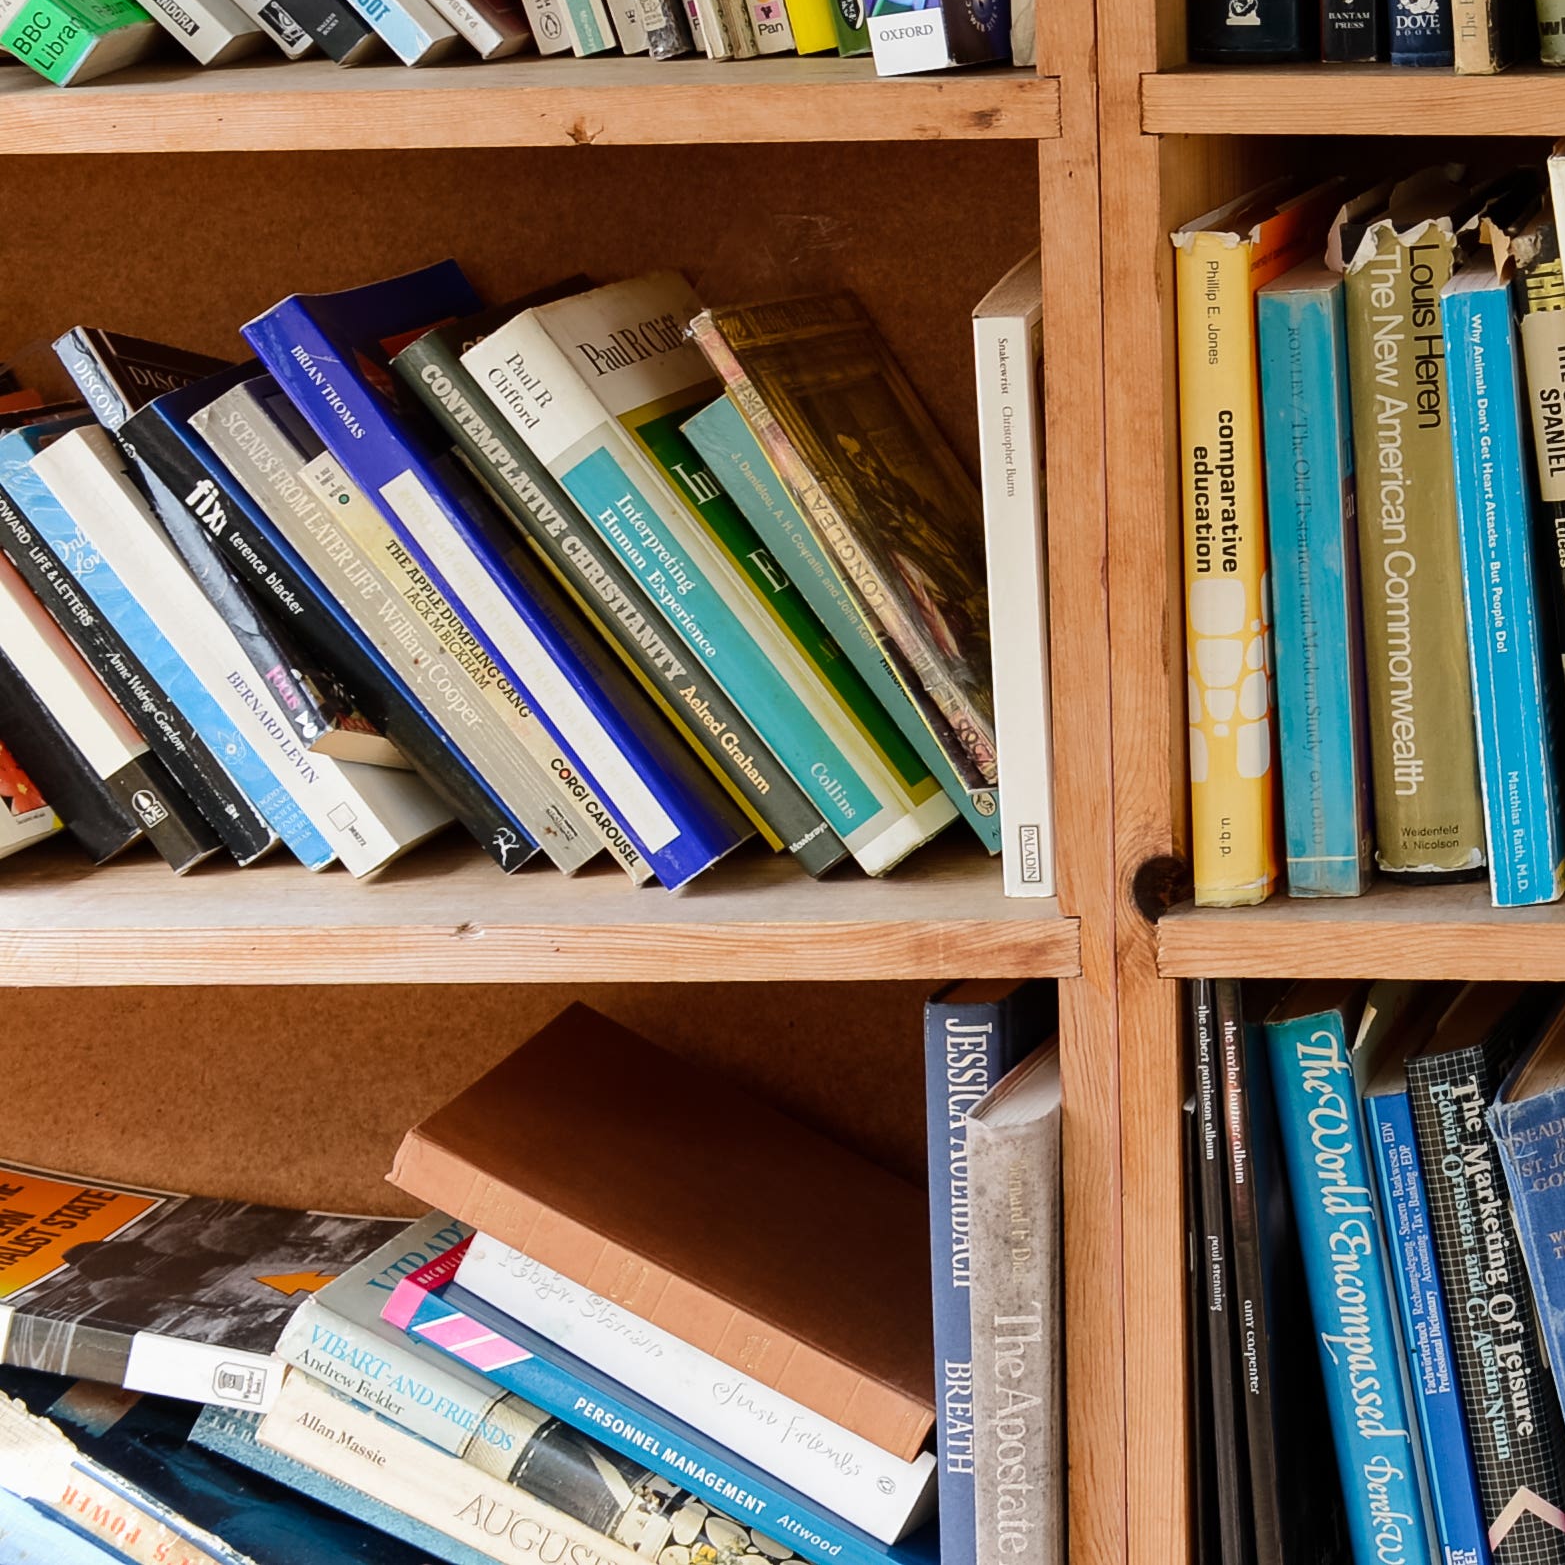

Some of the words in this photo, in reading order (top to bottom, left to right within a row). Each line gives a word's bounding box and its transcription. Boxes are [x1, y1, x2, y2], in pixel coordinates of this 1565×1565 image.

[879, 21, 934, 43] OXFORD
[488, 367, 540, 429] Clifford
[504, 350, 541, 392] Paul
[533, 388, 553, 409] R
[1194, 444, 1212, 576] education
[1218, 409, 1239, 575] comparative
[186, 478, 228, 542] fixx
[228, 530, 276, 583] terence
[263, 572, 305, 618] blacker
[226, 670, 290, 748] BERNARD
[279, 739, 320, 785] LEVIN
[549, 756, 591, 804] CORGI
[584, 799, 640, 870] CAROUSEL
[809, 761, 857, 821] Collins
[1022, 827, 1038, 881] PALADIN
[1224, 1021, 1237, 1043] the
[1297, 1030, 1352, 1095] The
[1226, 1045, 1239, 1086] taylor
[1229, 1089, 1242, 1139] lautner
[1452, 1076, 1480, 1134] The
[1232, 1141, 1247, 1184] album
[1311, 1093, 1371, 1217] World
[1463, 1140, 1510, 1285] Marketing
[1322, 1215, 1411, 1444] Encompassed
[1489, 1293, 1525, 1334] Of
[296, 1349, 355, 1387] Andrew
[355, 1379, 405, 1415] Fielder
[1495, 1341, 1534, 1437] Leisure
[296, 1412, 335, 1440] Allan
[336, 1430, 387, 1467] Massie
[574, 1397, 659, 1456] PERSONNEL
[660, 1448, 767, 1515] MANAGEMENT
[776, 1513, 842, 1557] Attwood
